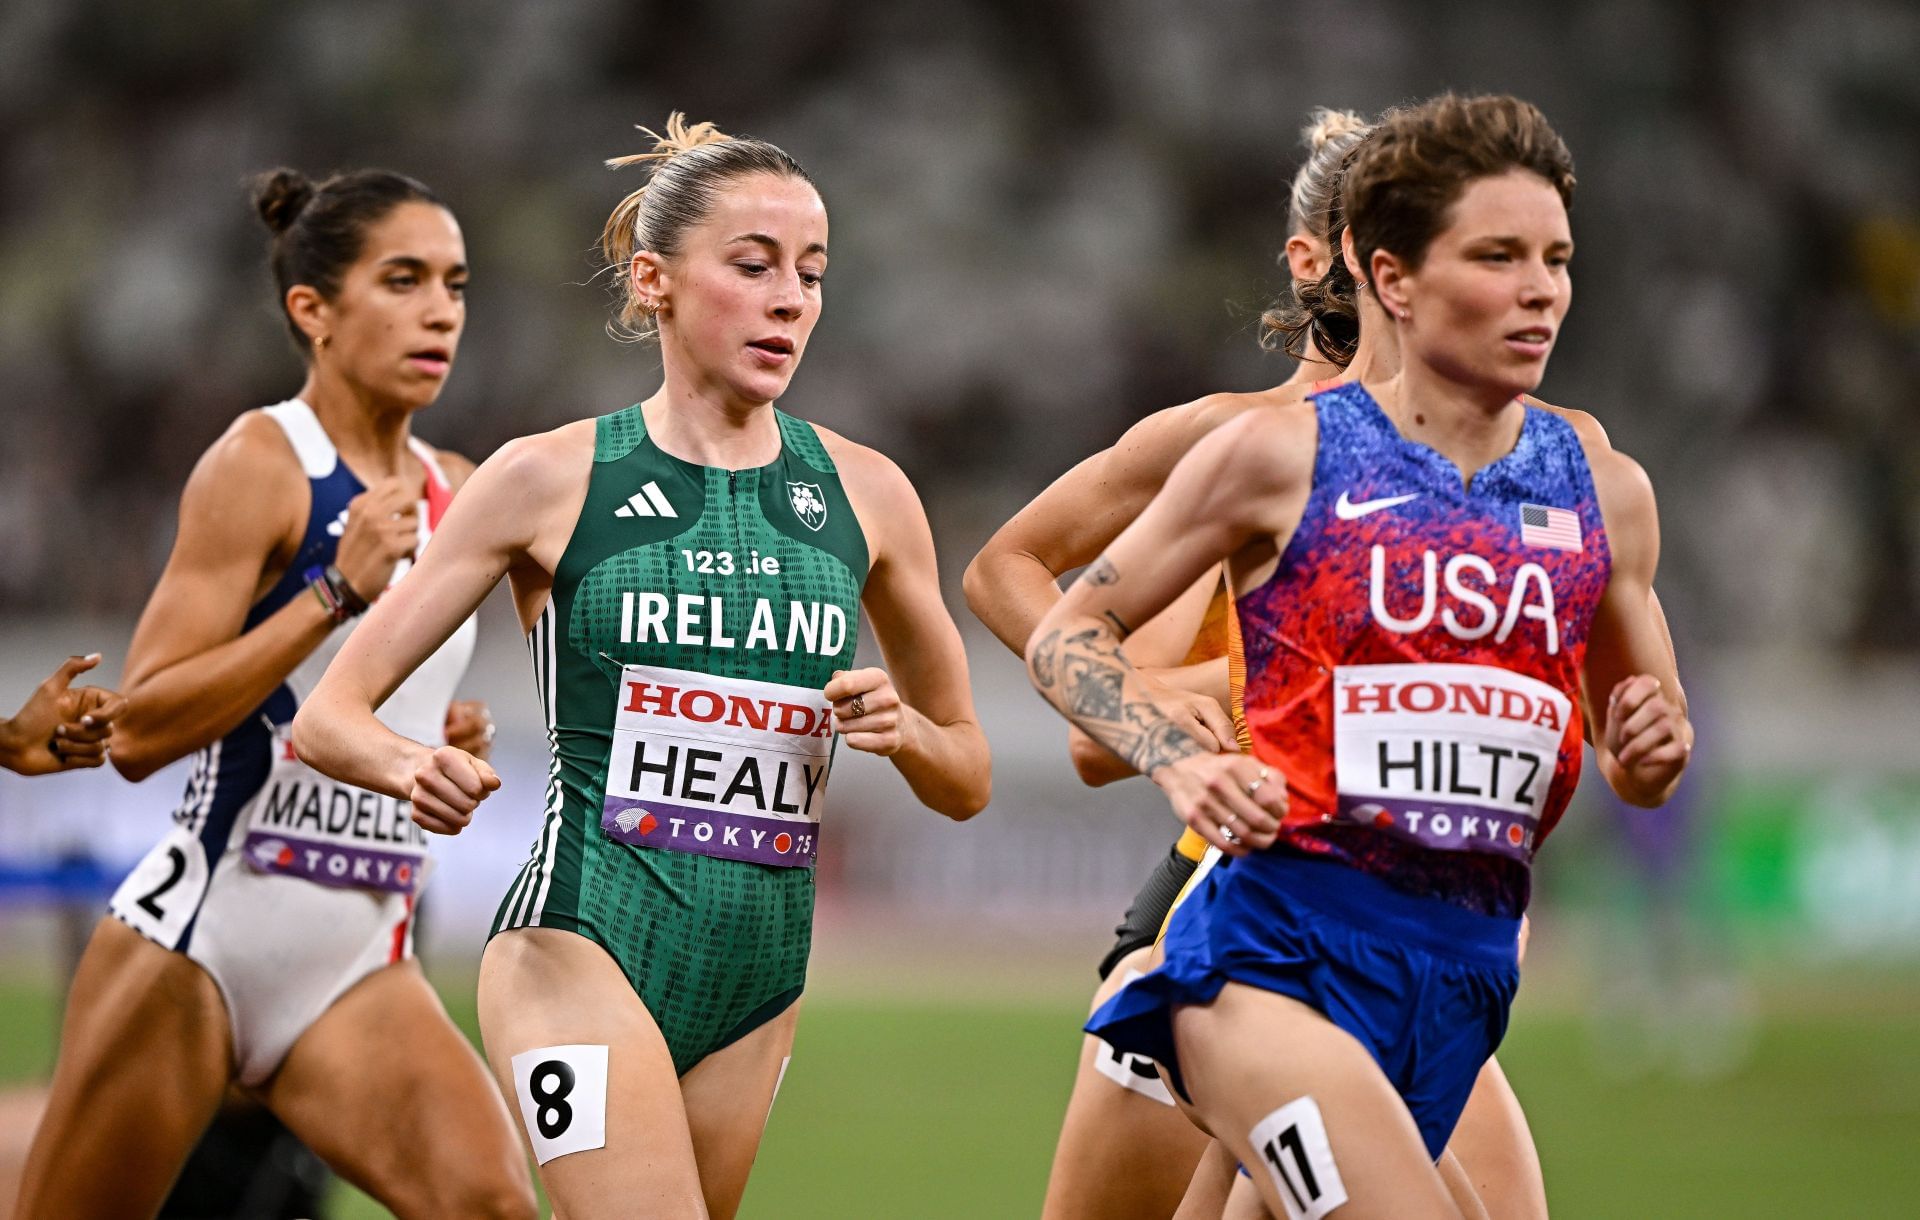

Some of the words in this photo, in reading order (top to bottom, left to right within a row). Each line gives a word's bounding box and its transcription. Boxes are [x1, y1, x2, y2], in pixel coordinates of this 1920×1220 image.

[620, 591, 847, 657] IRELAND
[1370, 544, 1559, 655] USA
[624, 681, 833, 738] HONDA
[1341, 680, 1561, 732] HONDA
[629, 740, 825, 816] HEALY
[1378, 740, 1541, 806] HILTZ
[669, 817, 792, 854] TOKYO
[1404, 810, 1525, 848] TOKYO
[137, 846, 186, 921] 2
[529, 1059, 576, 1140] 8
[1264, 1122, 1322, 1214] 11
